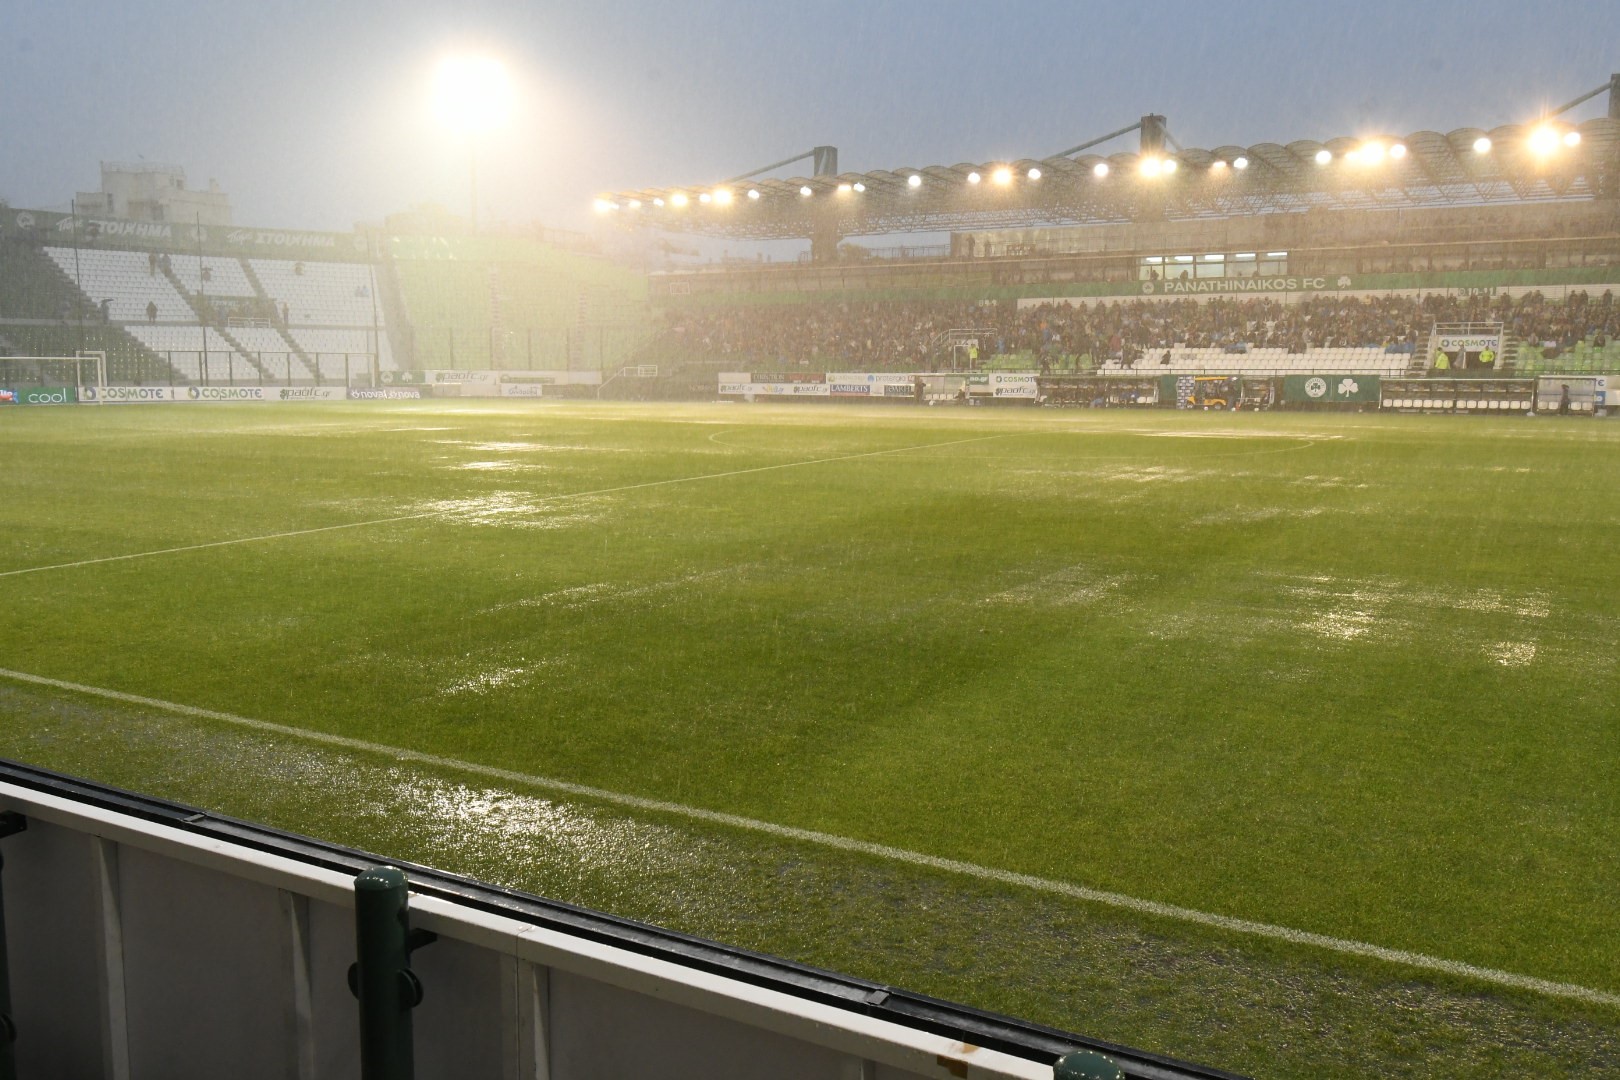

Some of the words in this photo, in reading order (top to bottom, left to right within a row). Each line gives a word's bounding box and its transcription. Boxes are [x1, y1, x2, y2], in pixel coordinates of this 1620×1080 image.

[1164, 278, 1297, 292] PANATHINAIKOS
[1302, 277, 1326, 289] FC
[101, 387, 164, 399] COSMOTE
[202, 388, 263, 399] COSMOTE
[831, 384, 868, 393] LAMBERTS
[28, 387, 66, 403] cool
